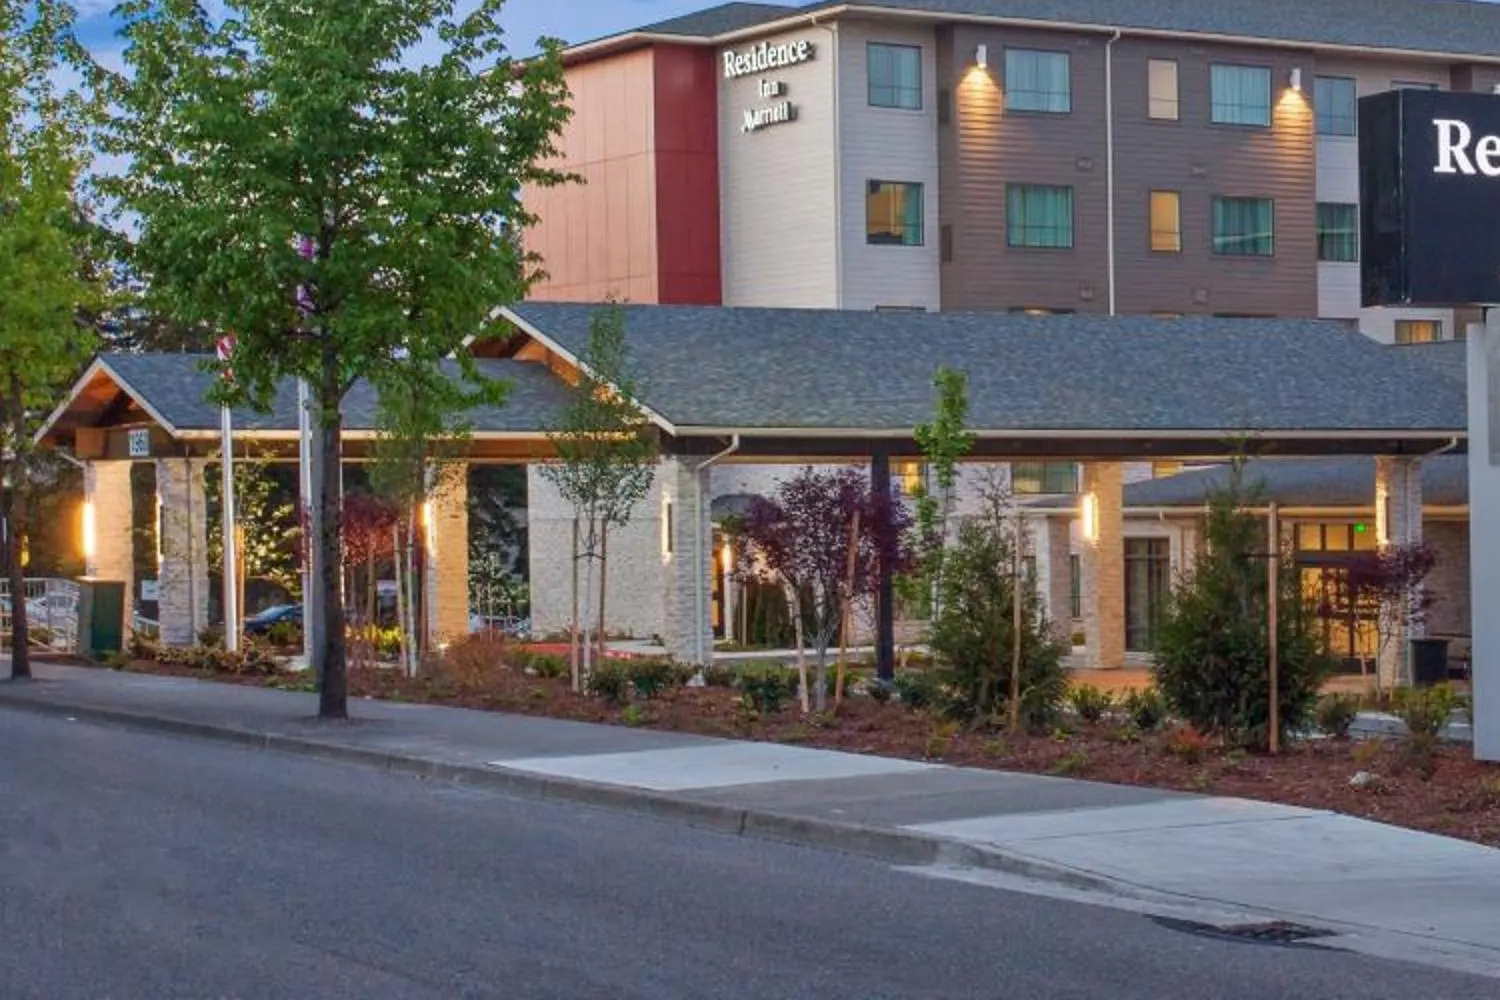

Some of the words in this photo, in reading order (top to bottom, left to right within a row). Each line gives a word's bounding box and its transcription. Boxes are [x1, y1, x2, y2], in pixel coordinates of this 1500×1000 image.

[723, 39, 808, 78] Residence
[758, 79, 781, 98] Inn
[740, 101, 791, 134] Marriott
